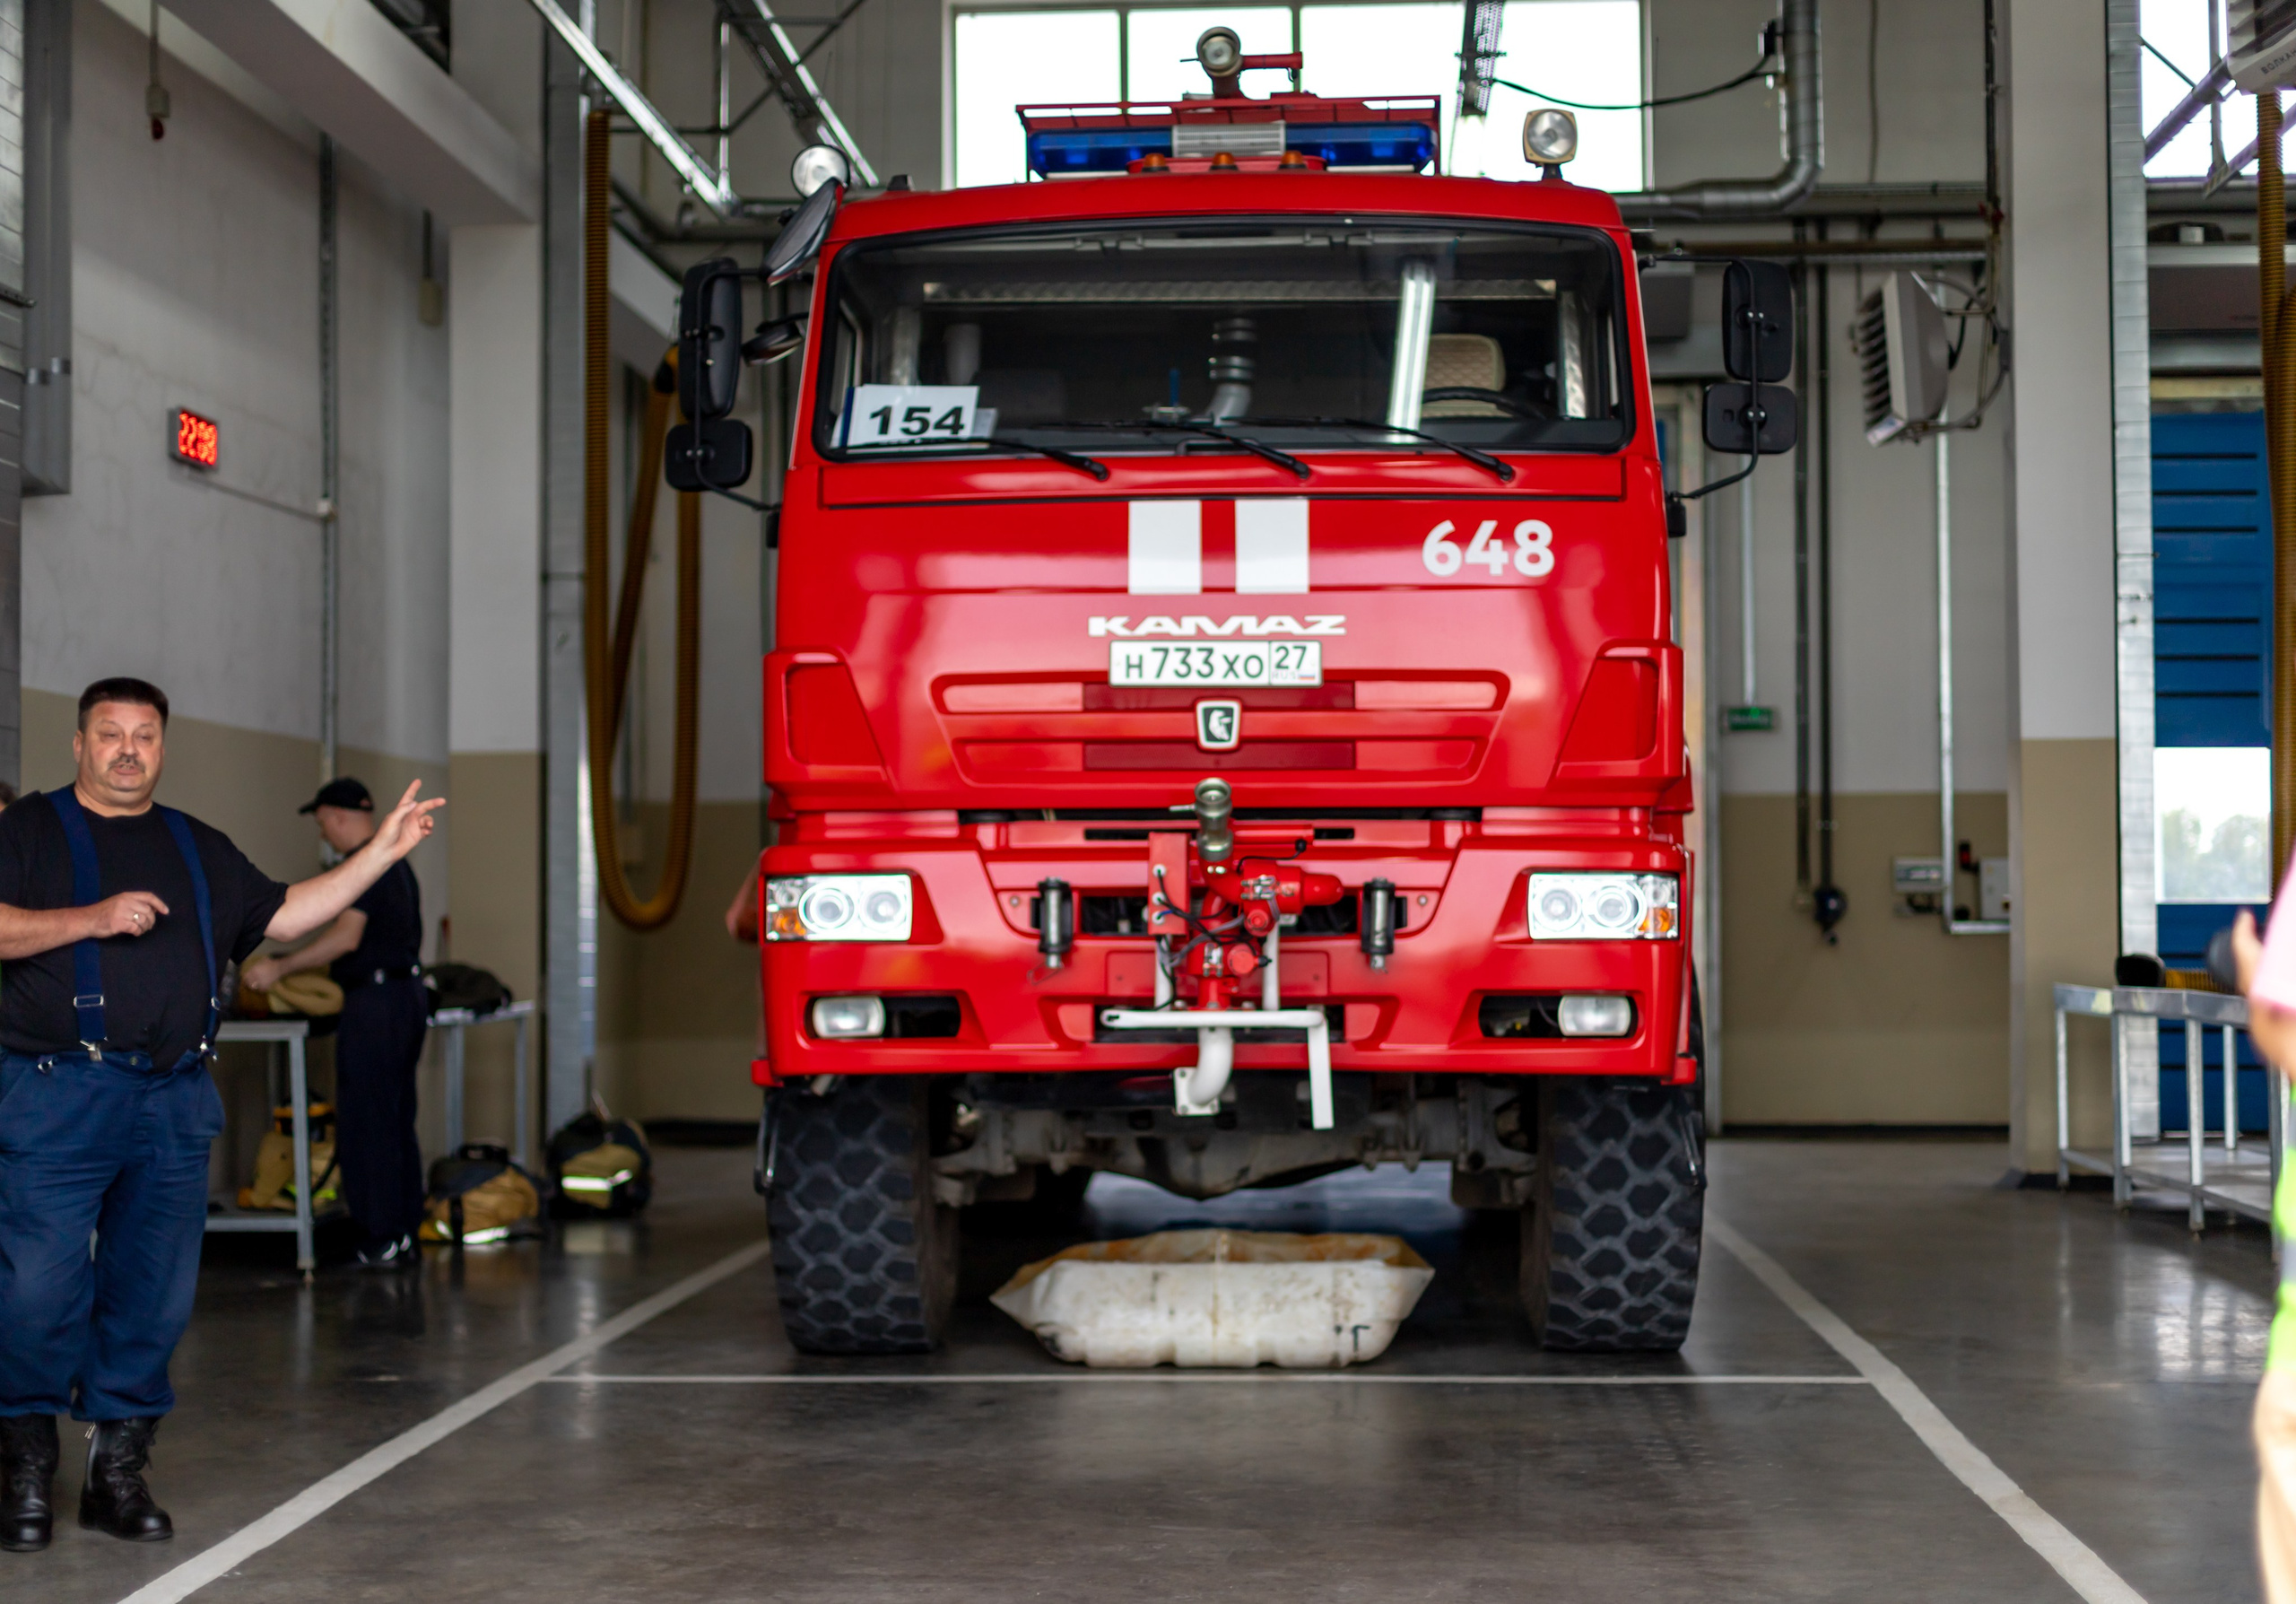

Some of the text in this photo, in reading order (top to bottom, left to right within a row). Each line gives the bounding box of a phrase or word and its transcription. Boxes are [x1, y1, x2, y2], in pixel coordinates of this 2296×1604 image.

[869, 405, 965, 436] 154
[1422, 519, 1555, 577] 648
[1088, 615, 1346, 637] KAMAZ
[1274, 645, 1307, 670] 27
